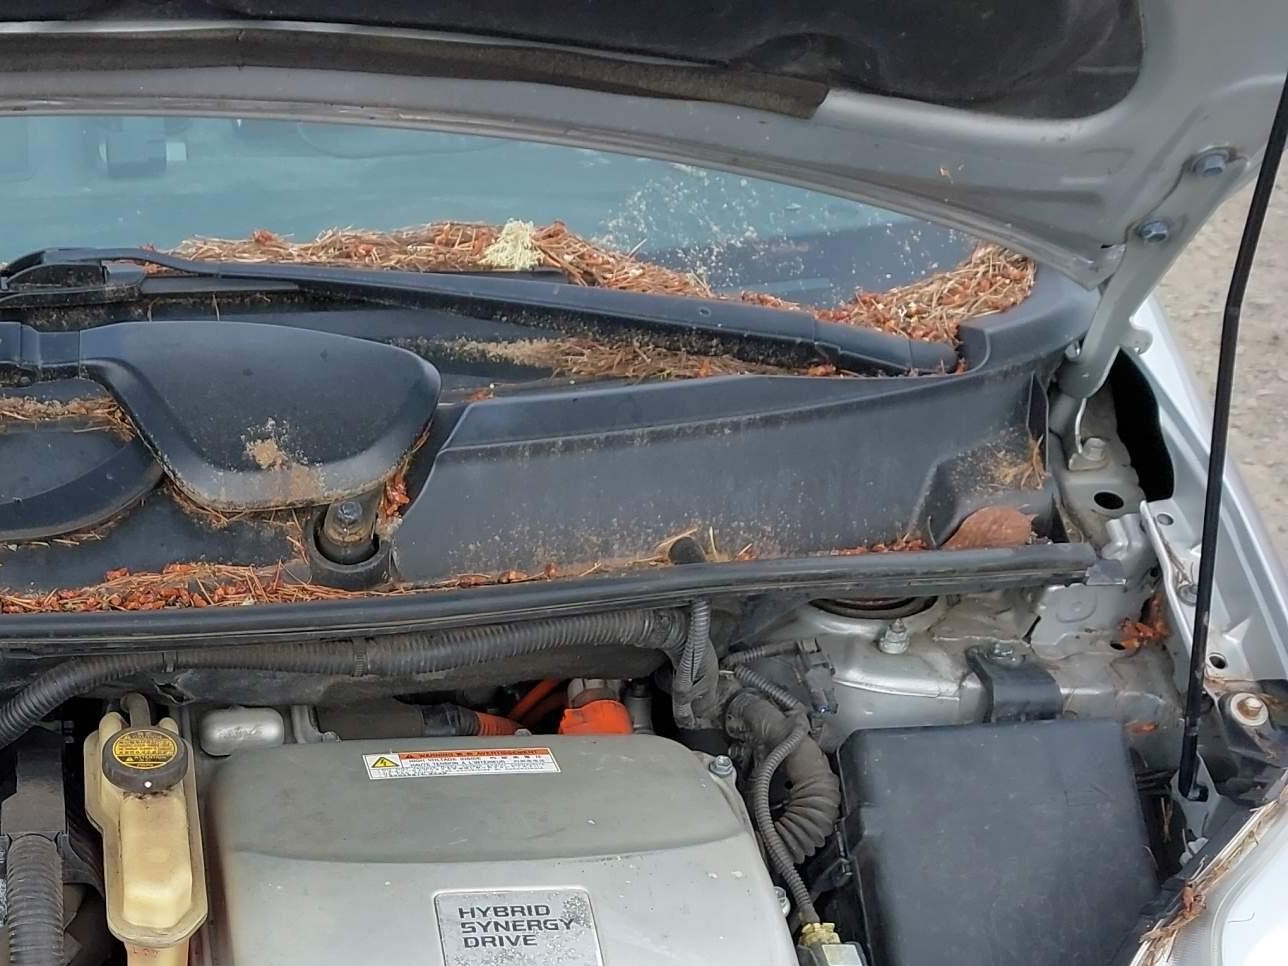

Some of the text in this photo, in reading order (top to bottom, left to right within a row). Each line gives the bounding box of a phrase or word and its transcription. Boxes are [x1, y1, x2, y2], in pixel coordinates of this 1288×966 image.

[458, 904, 551, 919] HYBRID
[461, 918, 575, 934] SYNERGY
[464, 934, 537, 948] DRIVE
